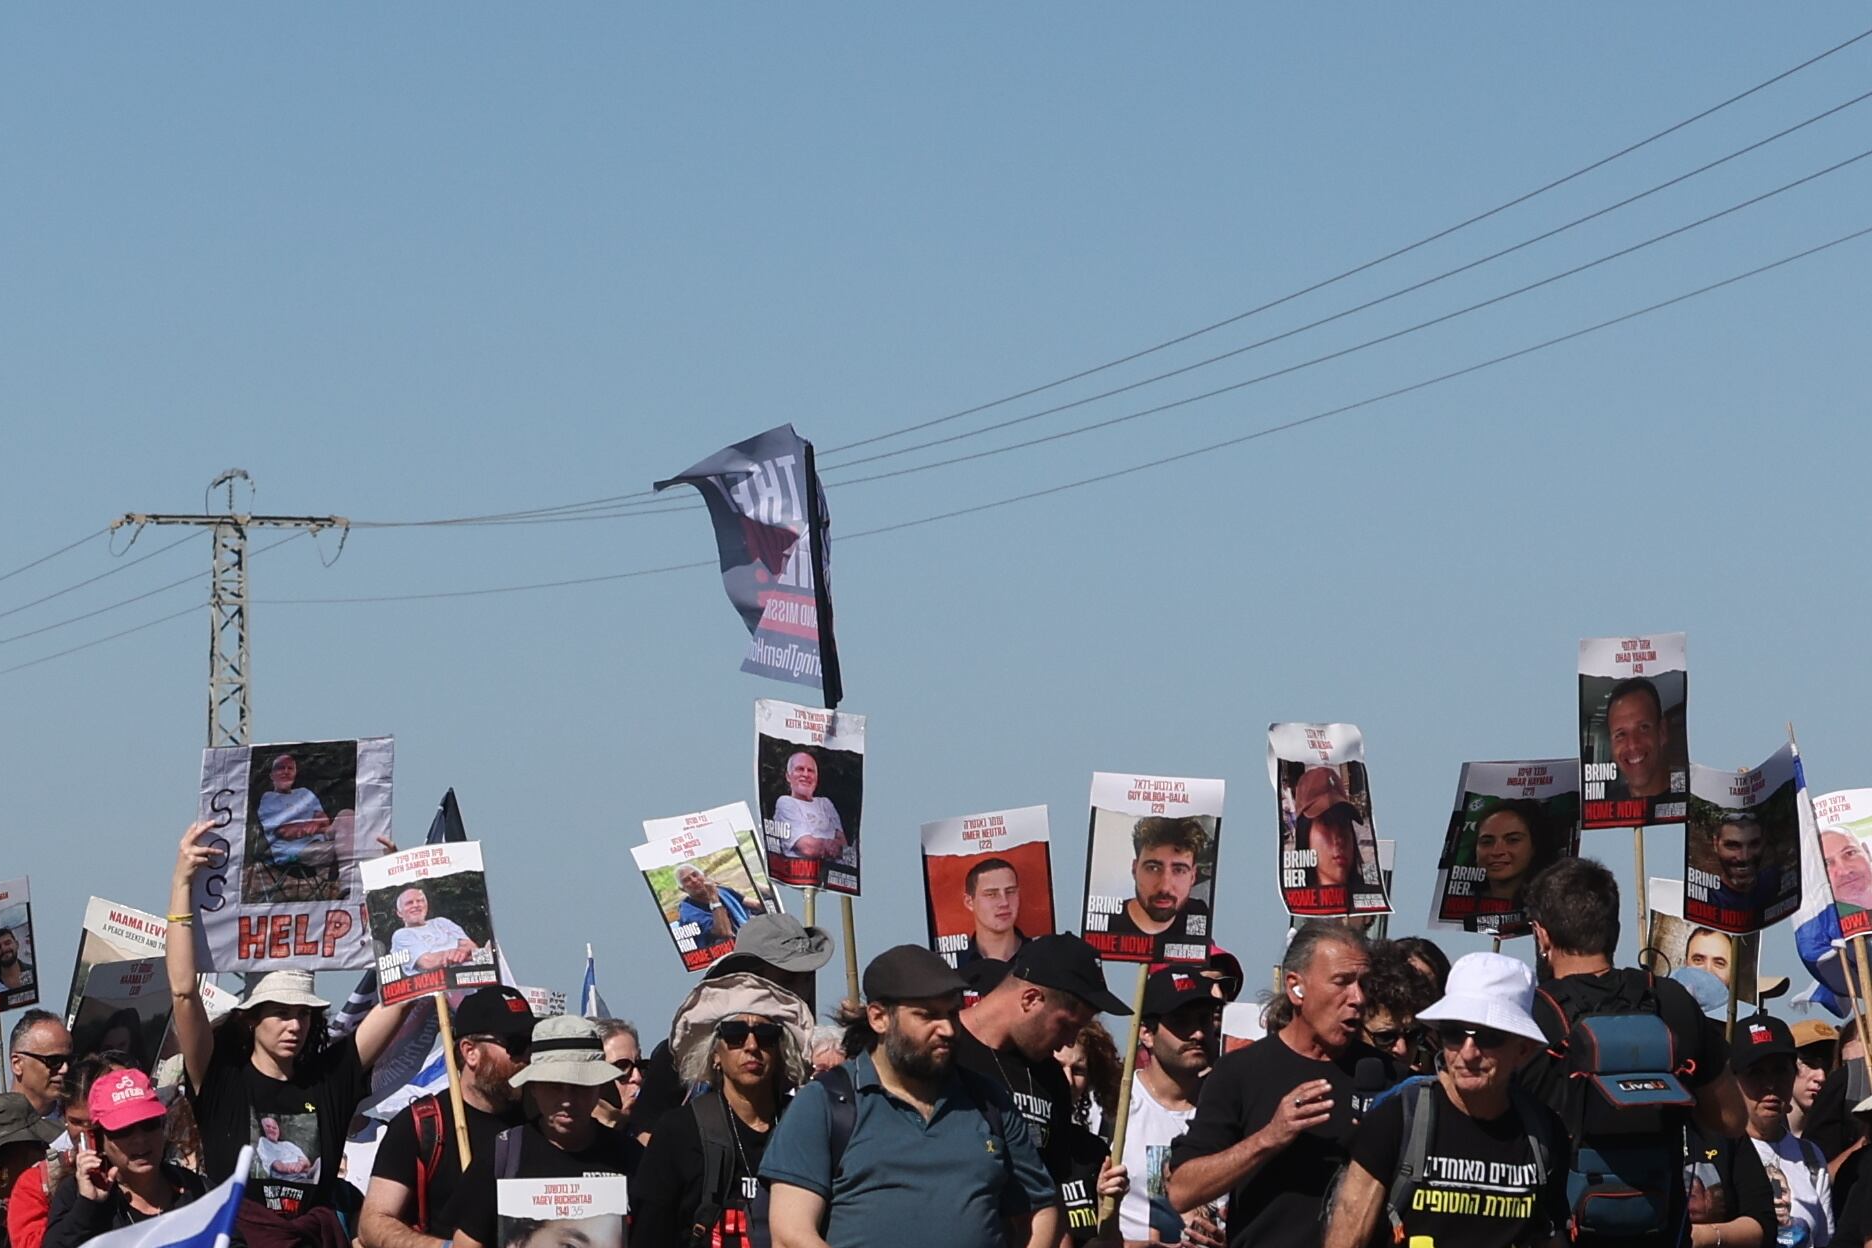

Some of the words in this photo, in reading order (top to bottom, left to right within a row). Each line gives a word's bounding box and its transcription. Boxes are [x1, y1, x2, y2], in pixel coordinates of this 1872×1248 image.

[1584, 762, 1617, 781] BRING
[1127, 791, 1141, 801] GUY
[1585, 782, 1605, 801] HIM
[1585, 802, 1614, 819] HOME
[764, 818, 791, 840] BRING
[1284, 849, 1318, 868] BRING
[1284, 869, 1306, 887] HER
[1451, 865, 1487, 882] BRING
[1688, 866, 1720, 890] BRING
[1285, 889, 1317, 906] HOME
[1688, 884, 1708, 903] HIM
[1088, 895, 1123, 915] BRING
[109, 911, 143, 932] NAAMA
[144, 922, 166, 939] LEVY
[238, 902, 370, 960] HELP!
[672, 922, 701, 940] BRING
[1086, 913, 1109, 931] HIM
[107, 926, 124, 937] PEACE
[125, 931, 146, 944] SEEKER
[147, 938, 157, 948] AND
[677, 937, 697, 953] HIM
[1120, 935, 1154, 954] NOW!
[379, 949, 410, 970] BRING
[684, 948, 711, 966] HOME
[380, 966, 402, 984] HIM
[383, 977, 412, 1000] HOME
[414, 968, 445, 989] NOW!
[1618, 1081, 1665, 1091] LiveU
[1489, 1162, 1538, 1185] צועדים
[532, 1195, 553, 1205] YAGEV
[554, 1194, 592, 1205] BUCHSHTAB
[1412, 1189, 1481, 1215] החטופים
[1483, 1193, 1536, 1218] החזרת
